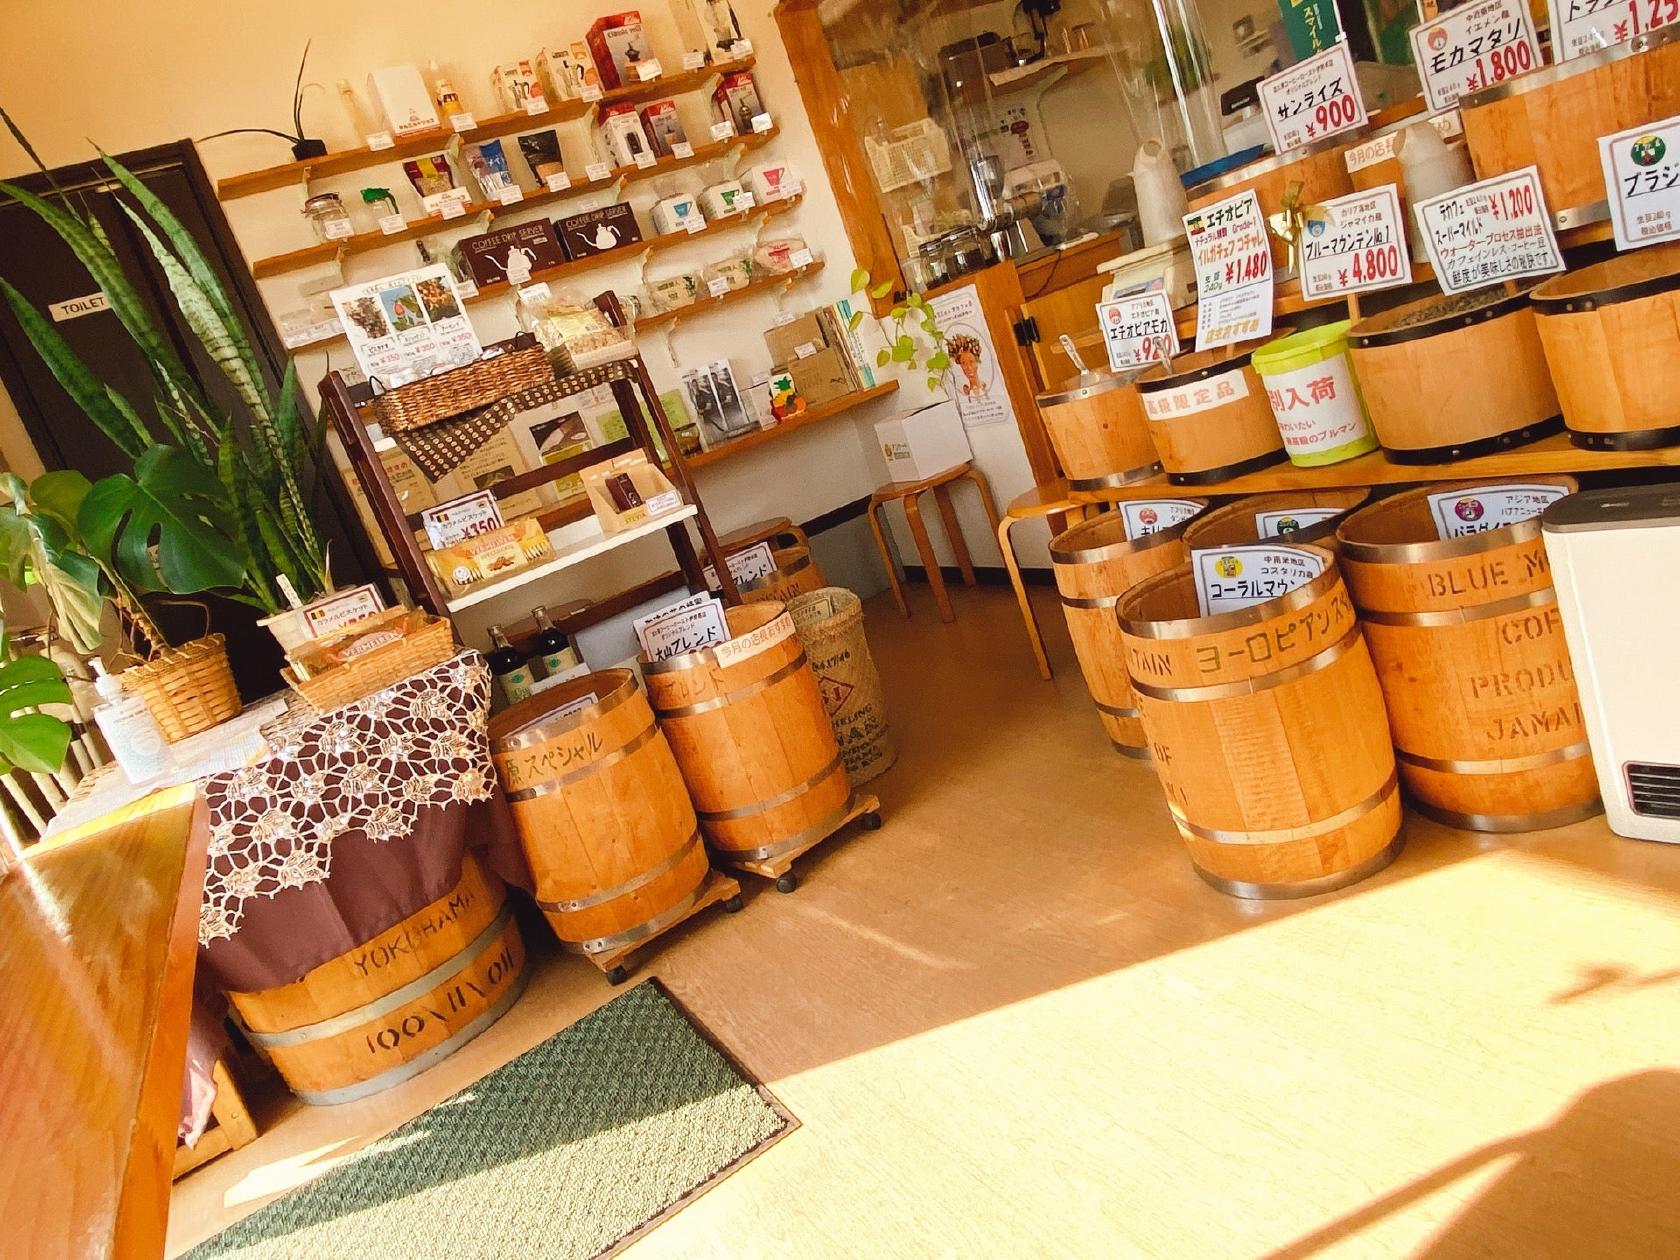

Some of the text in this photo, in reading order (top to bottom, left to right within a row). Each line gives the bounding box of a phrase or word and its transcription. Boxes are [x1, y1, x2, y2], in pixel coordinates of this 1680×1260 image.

[1430, 18, 1521, 73] モカマタリ
[1466, 40, 1530, 91] ¥1,800
[1306, 95, 1355, 138] ¥900
[1206, 198, 1253, 228] エチオピア
[472, 236, 502, 250] COFFEE
[1225, 250, 1267, 285] ¥1,480
[1338, 245, 1398, 287] ¥4,800
[61, 297, 104, 314] TOILET
[1111, 318, 1168, 339] エチオピアモカ
[1506, 495, 1549, 505] アジア地区
[1264, 555, 1306, 567] 中南米地区
[1428, 558, 1508, 597] BLUE
